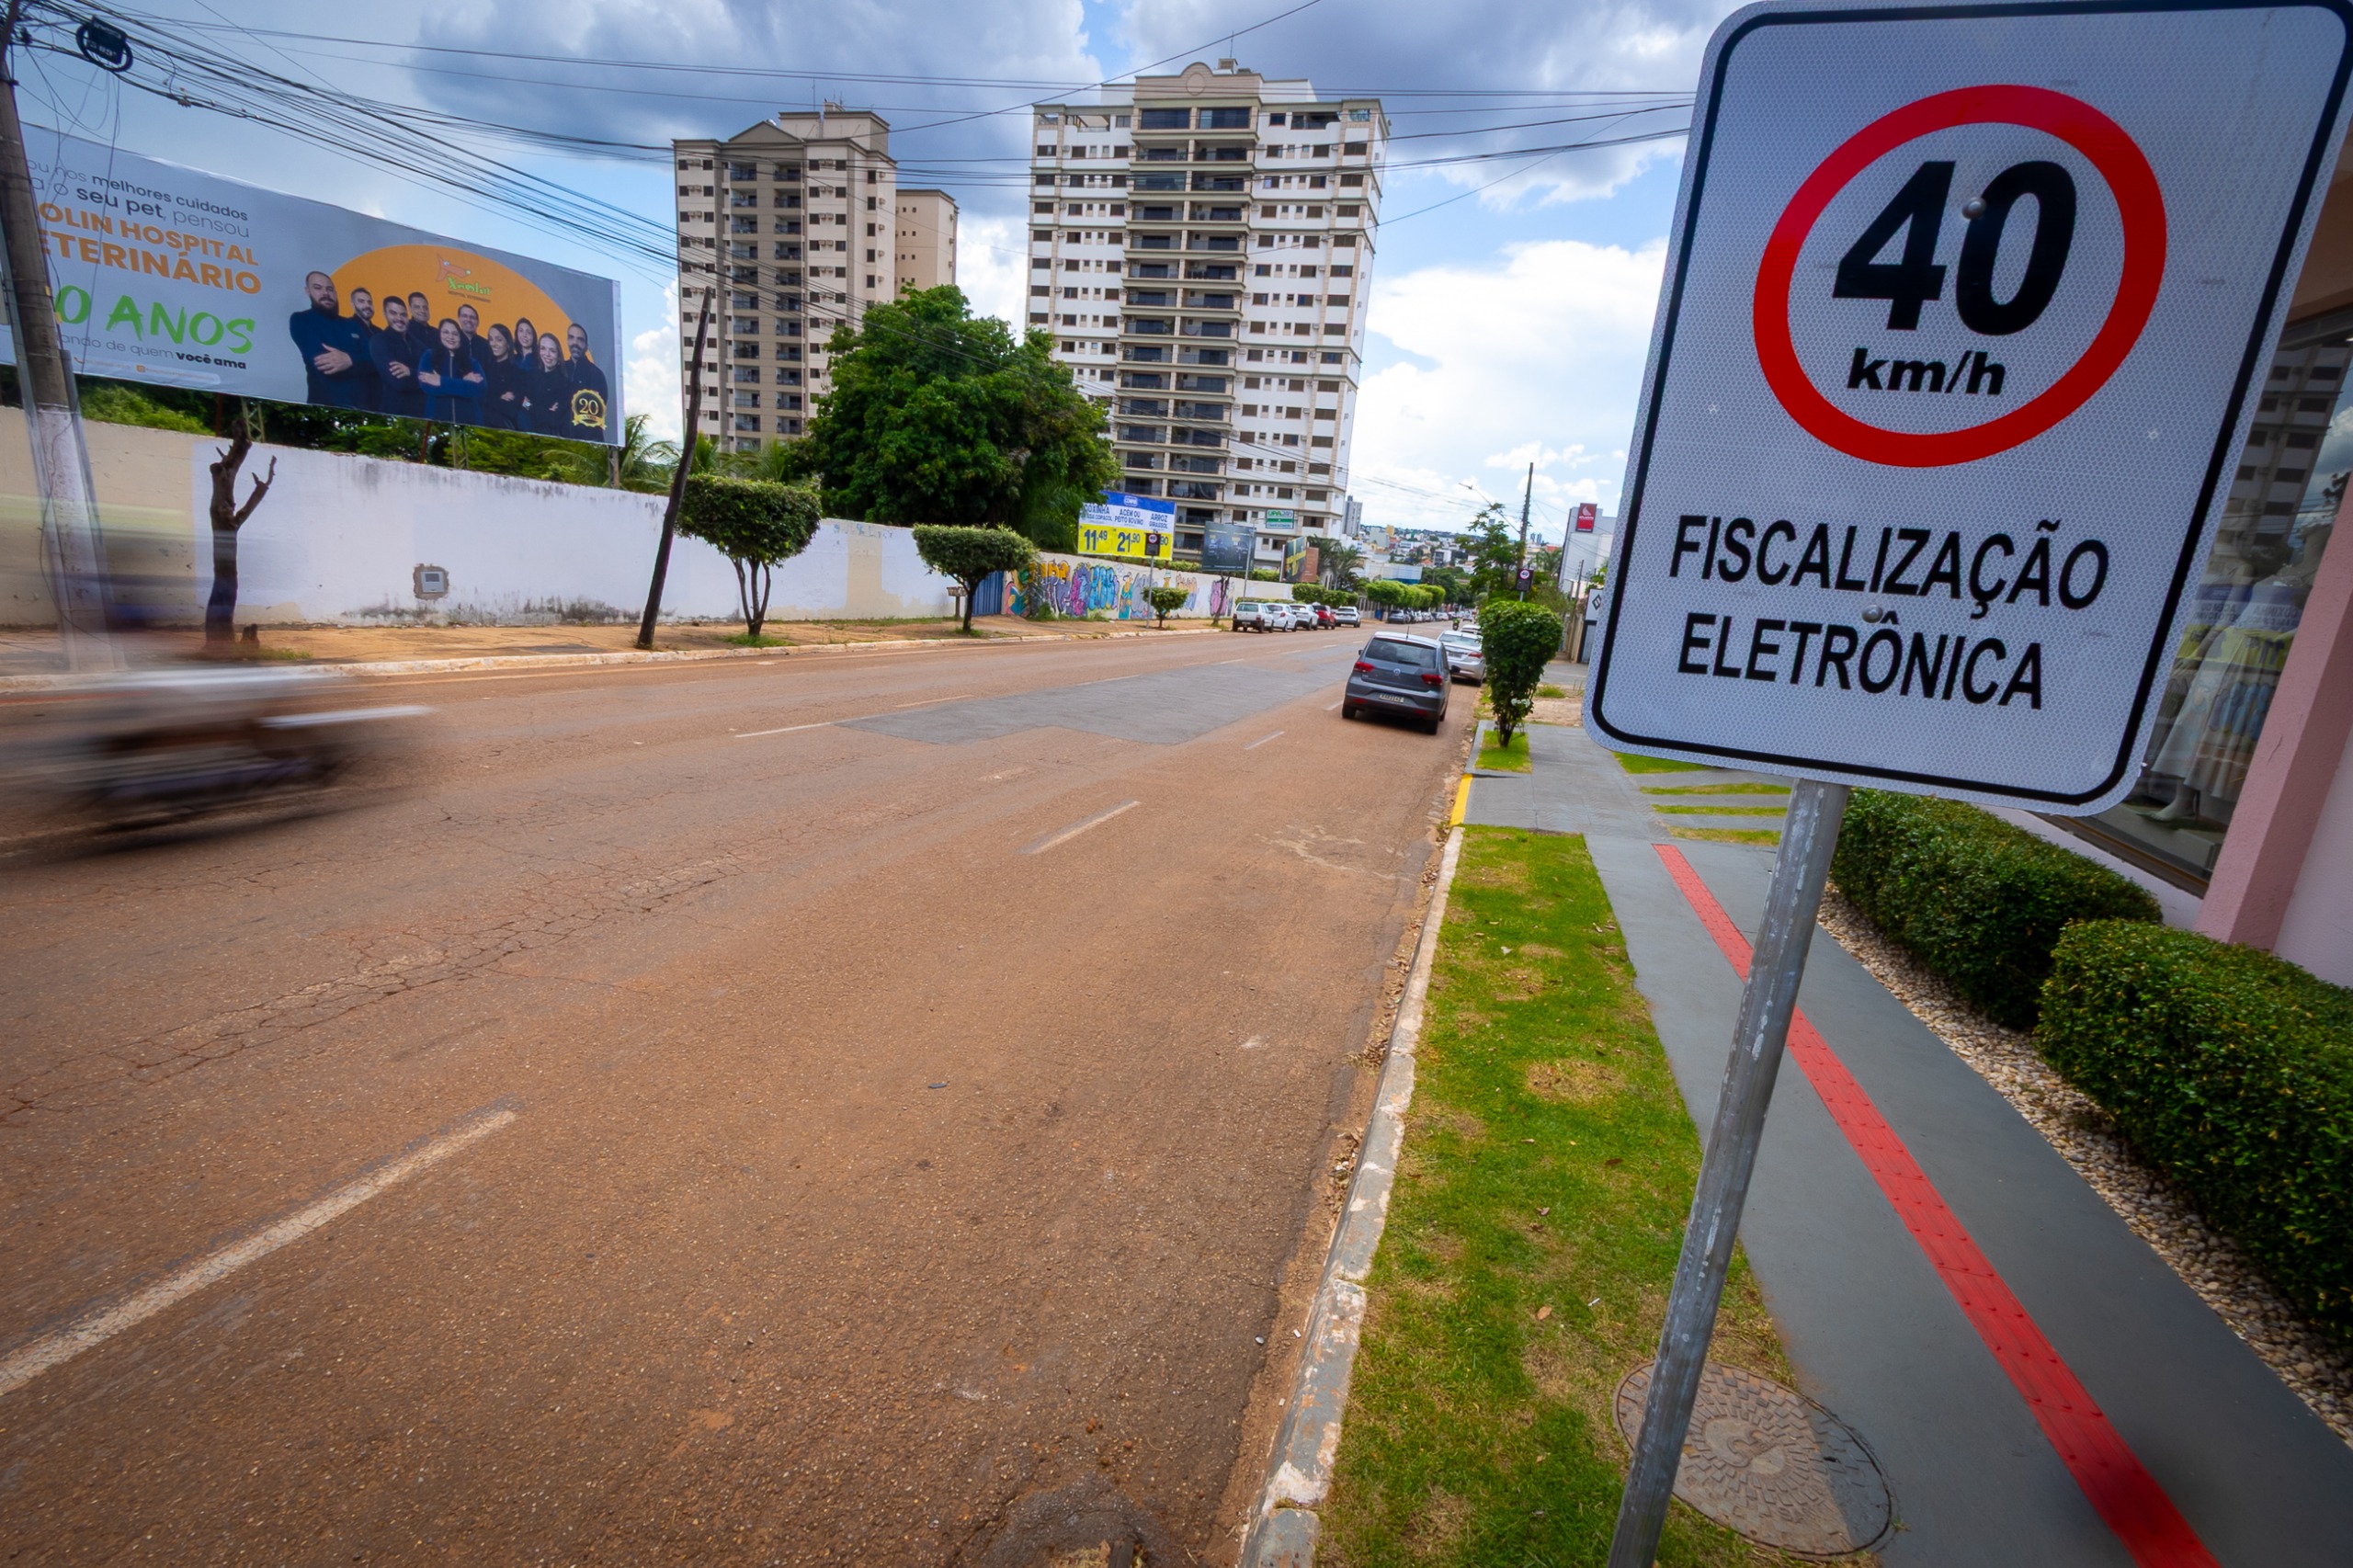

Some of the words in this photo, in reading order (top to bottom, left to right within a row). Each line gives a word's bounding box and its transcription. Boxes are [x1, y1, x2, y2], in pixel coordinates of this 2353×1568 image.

[28, 159, 49, 173] ou
[54, 166, 87, 182] nos
[92, 175, 172, 202] melhores
[176, 197, 248, 221] cuidados
[29, 177, 44, 190] a
[53, 183, 68, 196] o
[76, 187, 119, 208] seu
[126, 199, 166, 222] pet,
[173, 210, 249, 238] pensou
[38, 201, 113, 234] OLIN
[119, 219, 259, 266] HOSPITAL
[1832, 161, 2076, 335] 40
[53, 285, 91, 324] 0
[105, 294, 256, 354] ANOS
[59, 334, 101, 348] ando
[106, 339, 126, 351] de
[130, 345, 174, 358] quem
[175, 352, 211, 364] você
[213, 358, 247, 369] ama
[1847, 347, 2006, 395] km/h
[579, 397, 599, 415] 20
[1151, 513, 1168, 522] ARROZ
[1669, 515, 2109, 619] FISCALIZAÇÃO
[1677, 610, 2042, 710] ELETRÔNICA
